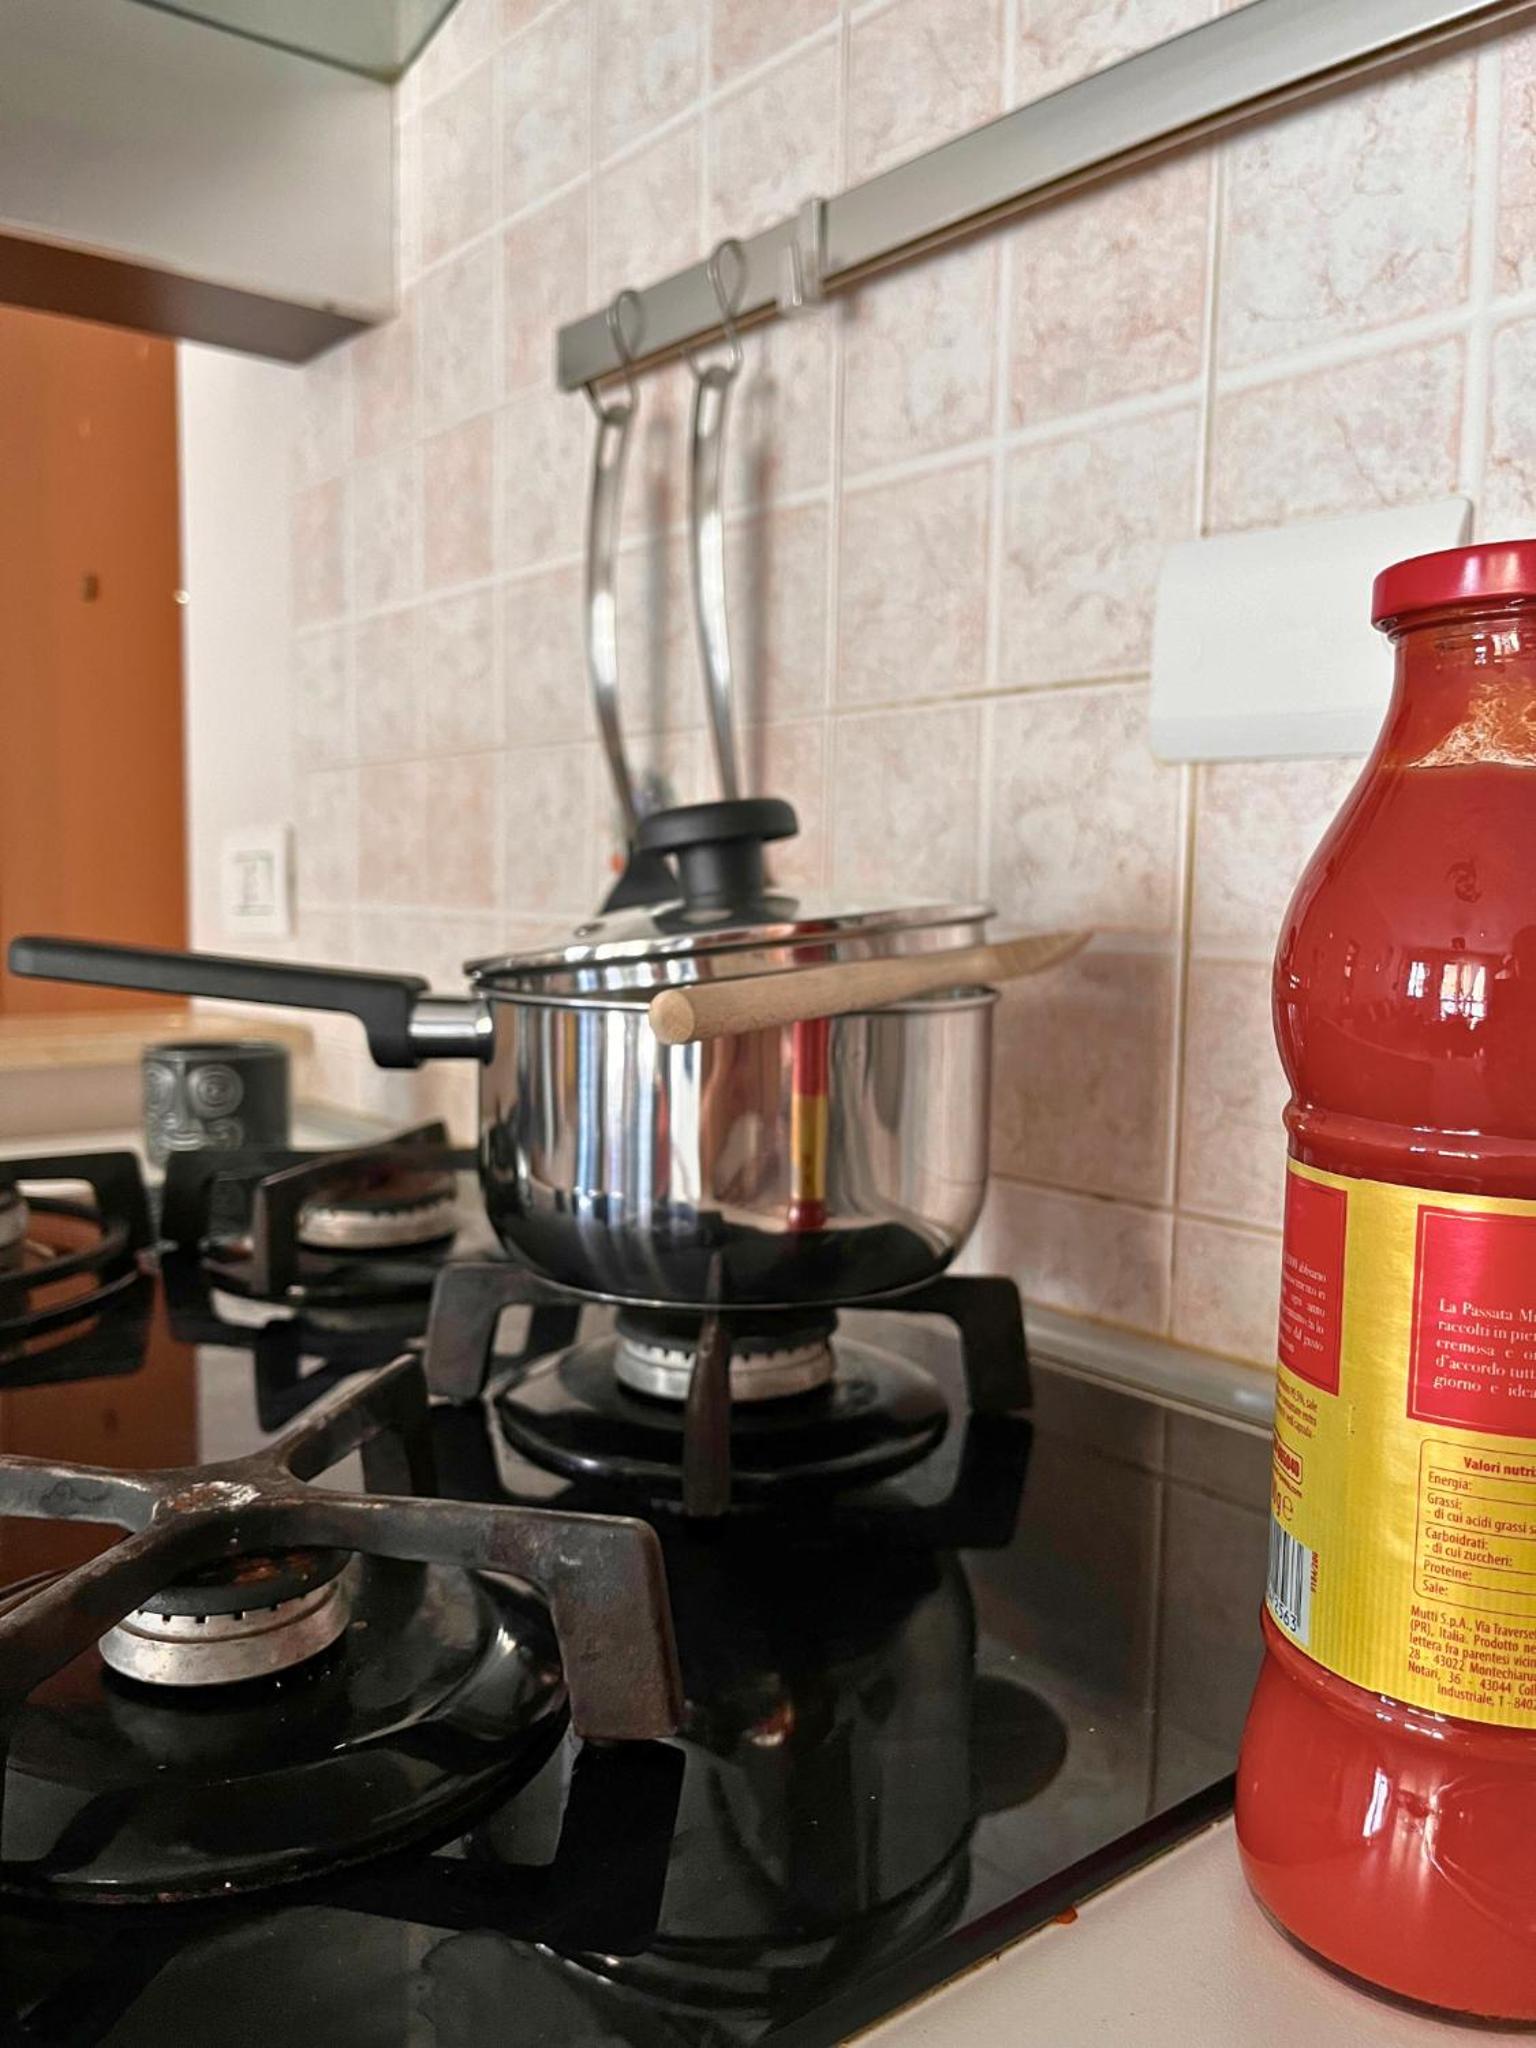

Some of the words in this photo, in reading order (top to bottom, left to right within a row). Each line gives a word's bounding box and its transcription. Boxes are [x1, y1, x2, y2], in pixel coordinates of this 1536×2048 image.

[1439, 1298, 1457, 1314] La
[1463, 1301, 1513, 1321] Passata
[1438, 1321, 1491, 1338] raccolti
[1493, 1325, 1507, 1339] in
[1436, 1340, 1495, 1356] cremosa
[1505, 1349, 1514, 1359] e
[1436, 1354, 1506, 1377] d'accordo
[1433, 1374, 1482, 1393] giorno
[1464, 1456, 1500, 1474] Valori
[1428, 1471, 1473, 1491] Energia:
[1427, 1492, 1463, 1510] Grassi:
[1434, 1507, 1444, 1520] di
[1447, 1511, 1463, 1523] cui
[1466, 1515, 1492, 1529] acidi
[1494, 1519, 1526, 1534] grassi
[1425, 1527, 1488, 1550] Carboidrati:
[1432, 1541, 1443, 1555] di
[1445, 1545, 1461, 1558] cui
[1464, 1551, 1513, 1568] zuccheri:
[1424, 1559, 1473, 1582] Proteine:
[1423, 1580, 1449, 1597] Sale:
[1411, 1604, 1438, 1623] Mutti
[1475, 1619, 1490, 1634] Via
[1410, 1632, 1442, 1652] lettera
[1445, 1642, 1459, 1656] fra
[1462, 1649, 1510, 1667] parentesi
[1474, 1633, 1519, 1652] Prodotto
[1433, 1653, 1465, 1673] 43022
[1437, 1683, 1494, 1707] Industriale,
